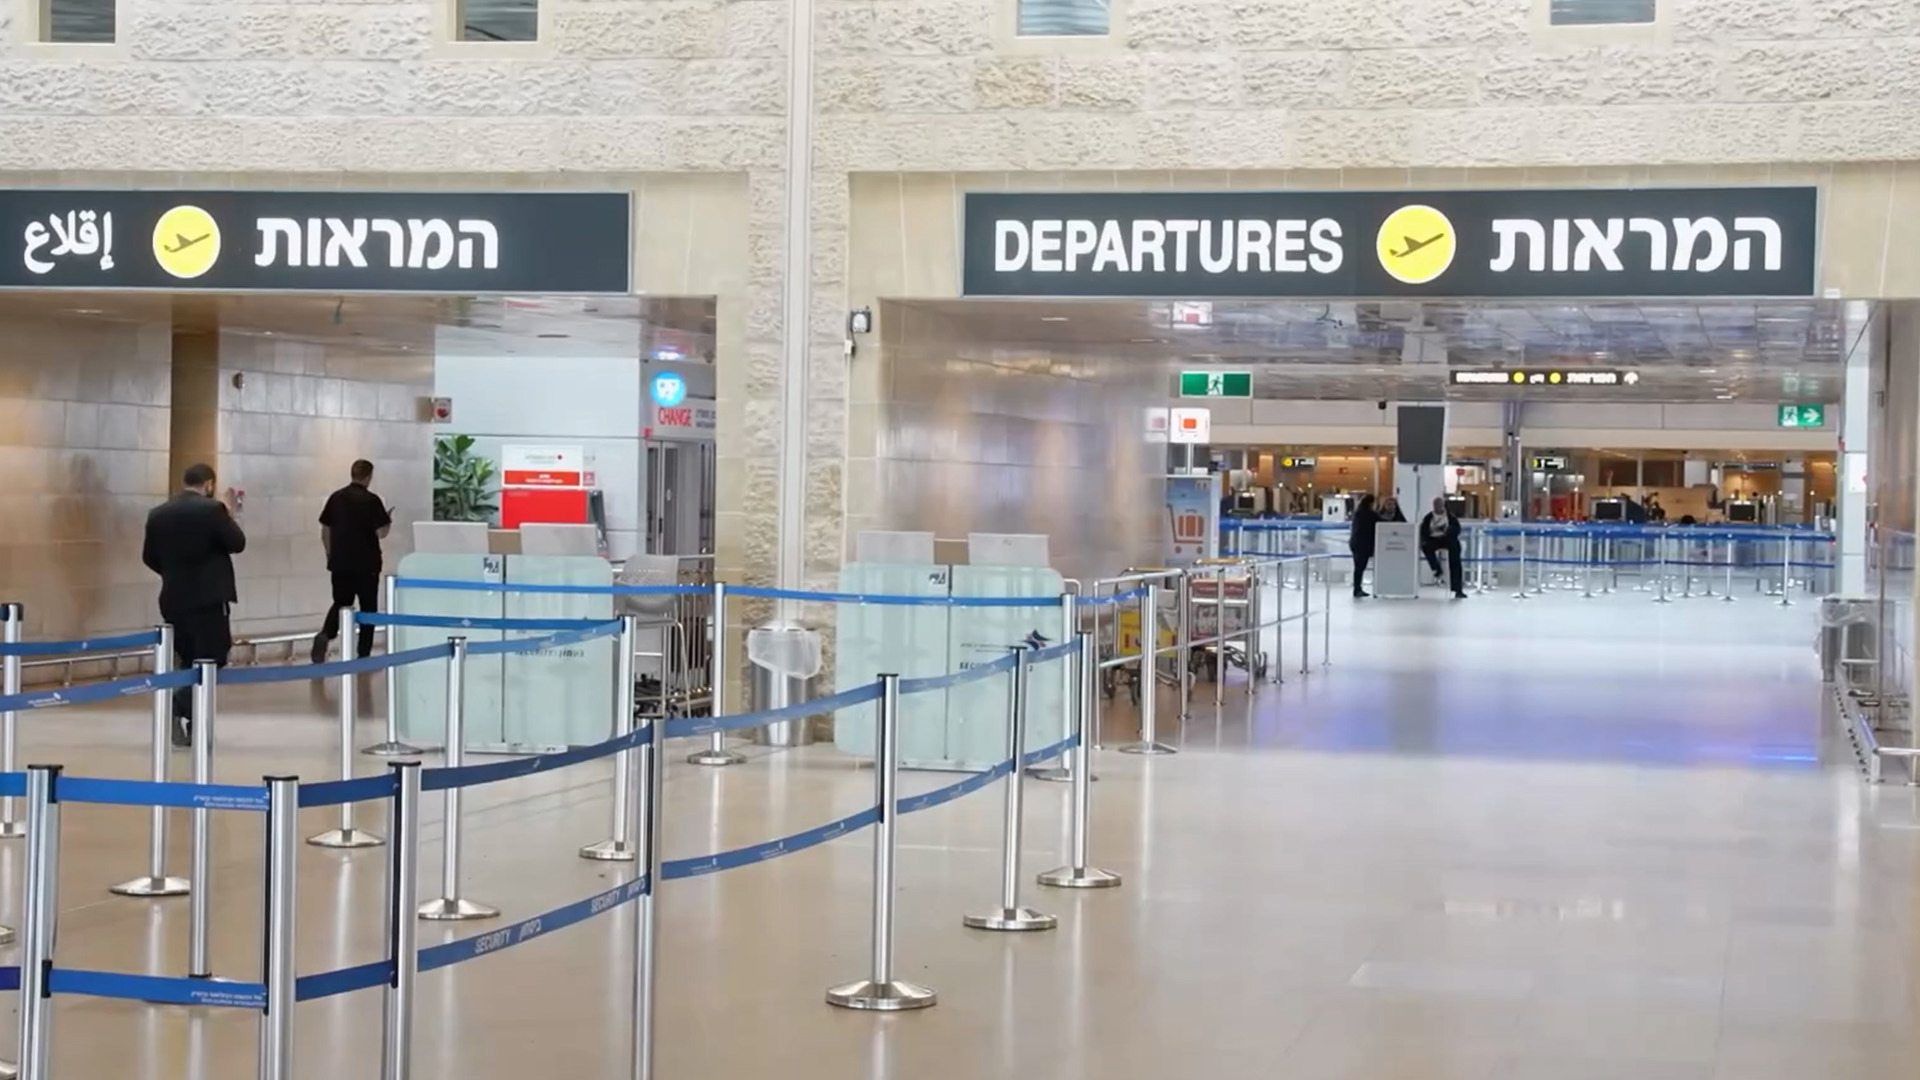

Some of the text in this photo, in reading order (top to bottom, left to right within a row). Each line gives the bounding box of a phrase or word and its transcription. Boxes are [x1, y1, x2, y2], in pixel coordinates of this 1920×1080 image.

[23, 209, 115, 274] إقلاع
[254, 217, 499, 270] המראות
[994, 217, 1344, 274] DEPARTURES
[1489, 216, 1782, 273] המראות
[658, 407, 692, 427] CHANGE
[475, 928, 512, 954] SECURITY
